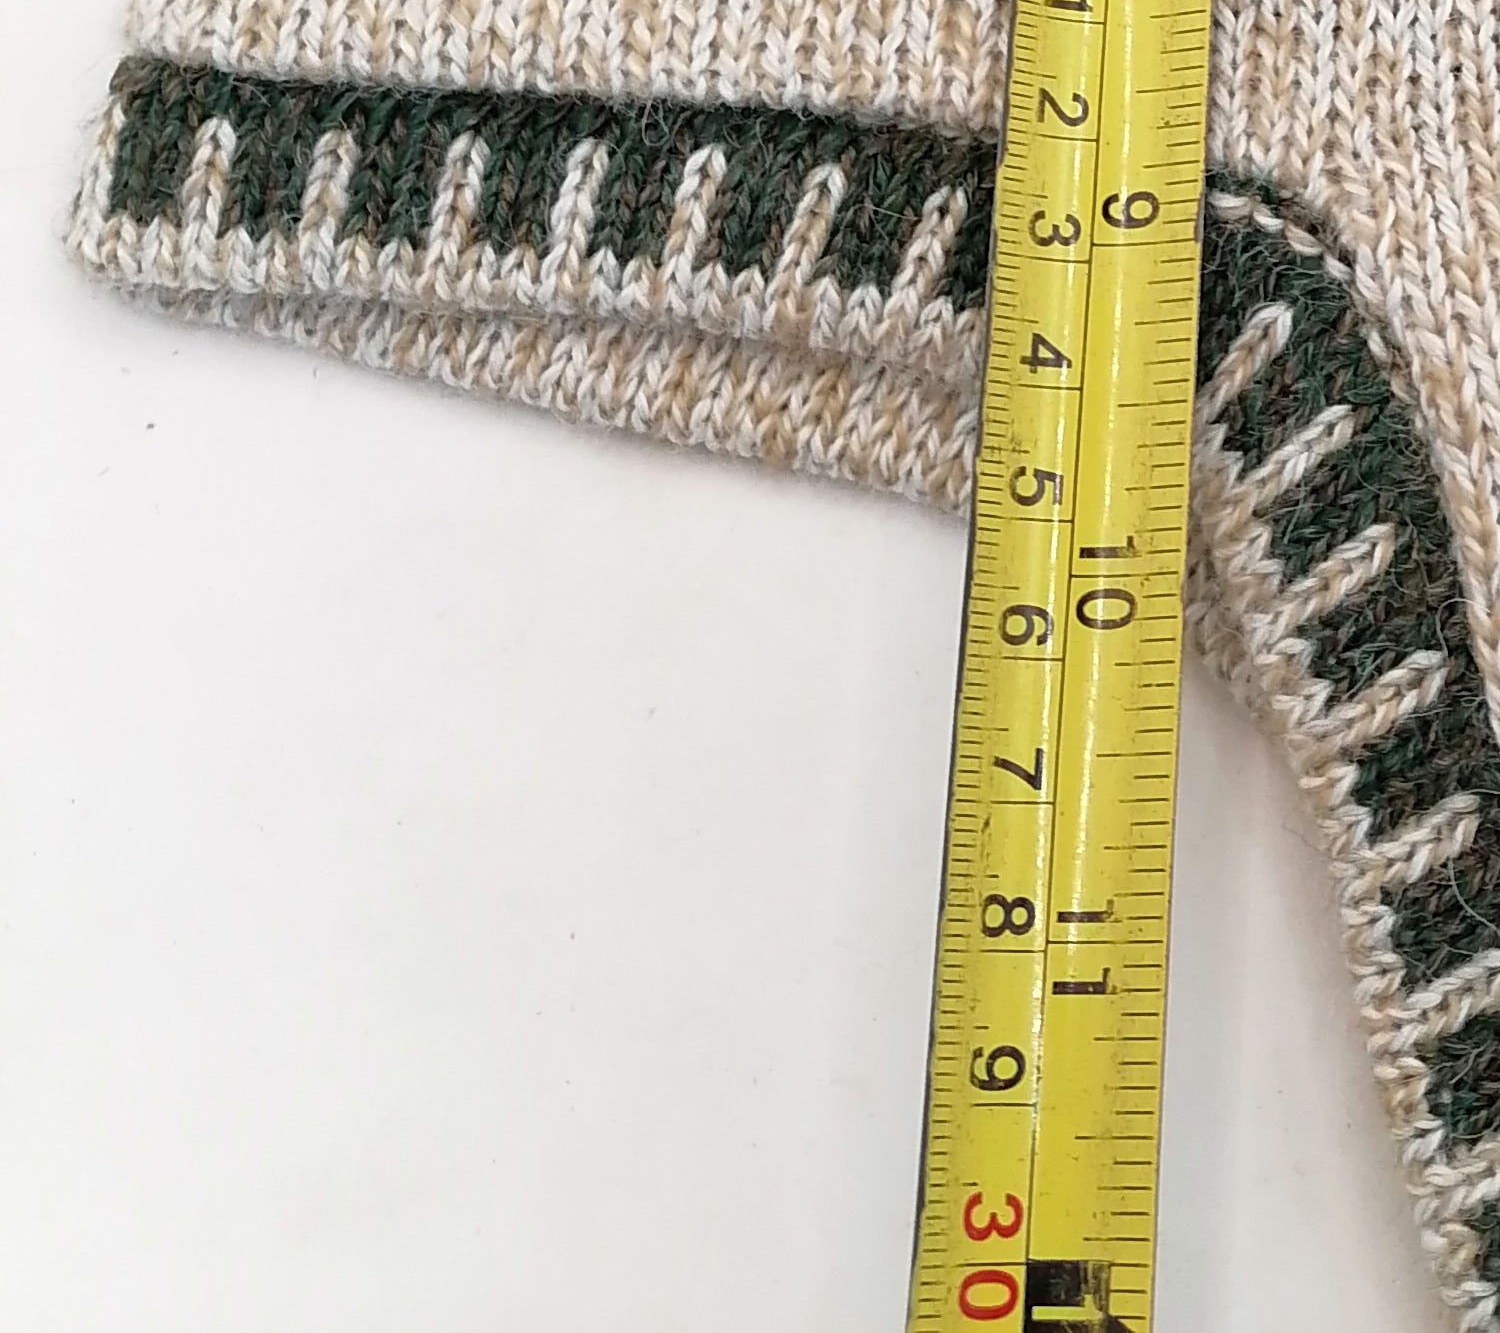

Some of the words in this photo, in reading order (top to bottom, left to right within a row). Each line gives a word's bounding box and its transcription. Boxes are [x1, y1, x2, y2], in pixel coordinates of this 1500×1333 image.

[1037, 87, 1089, 127] 2
[1028, 210, 1081, 247] 3
[1101, 191, 1160, 230] 9
[1019, 333, 1072, 374] 4
[1009, 466, 1064, 506] 5
[1076, 535, 1143, 630] 10
[1000, 604, 1055, 646] 6
[993, 747, 1044, 790] 7
[980, 893, 1036, 938] 8
[1052, 898, 1123, 995] 11
[970, 1045, 1026, 1092] 9
[958, 1191, 1024, 1321] 30
